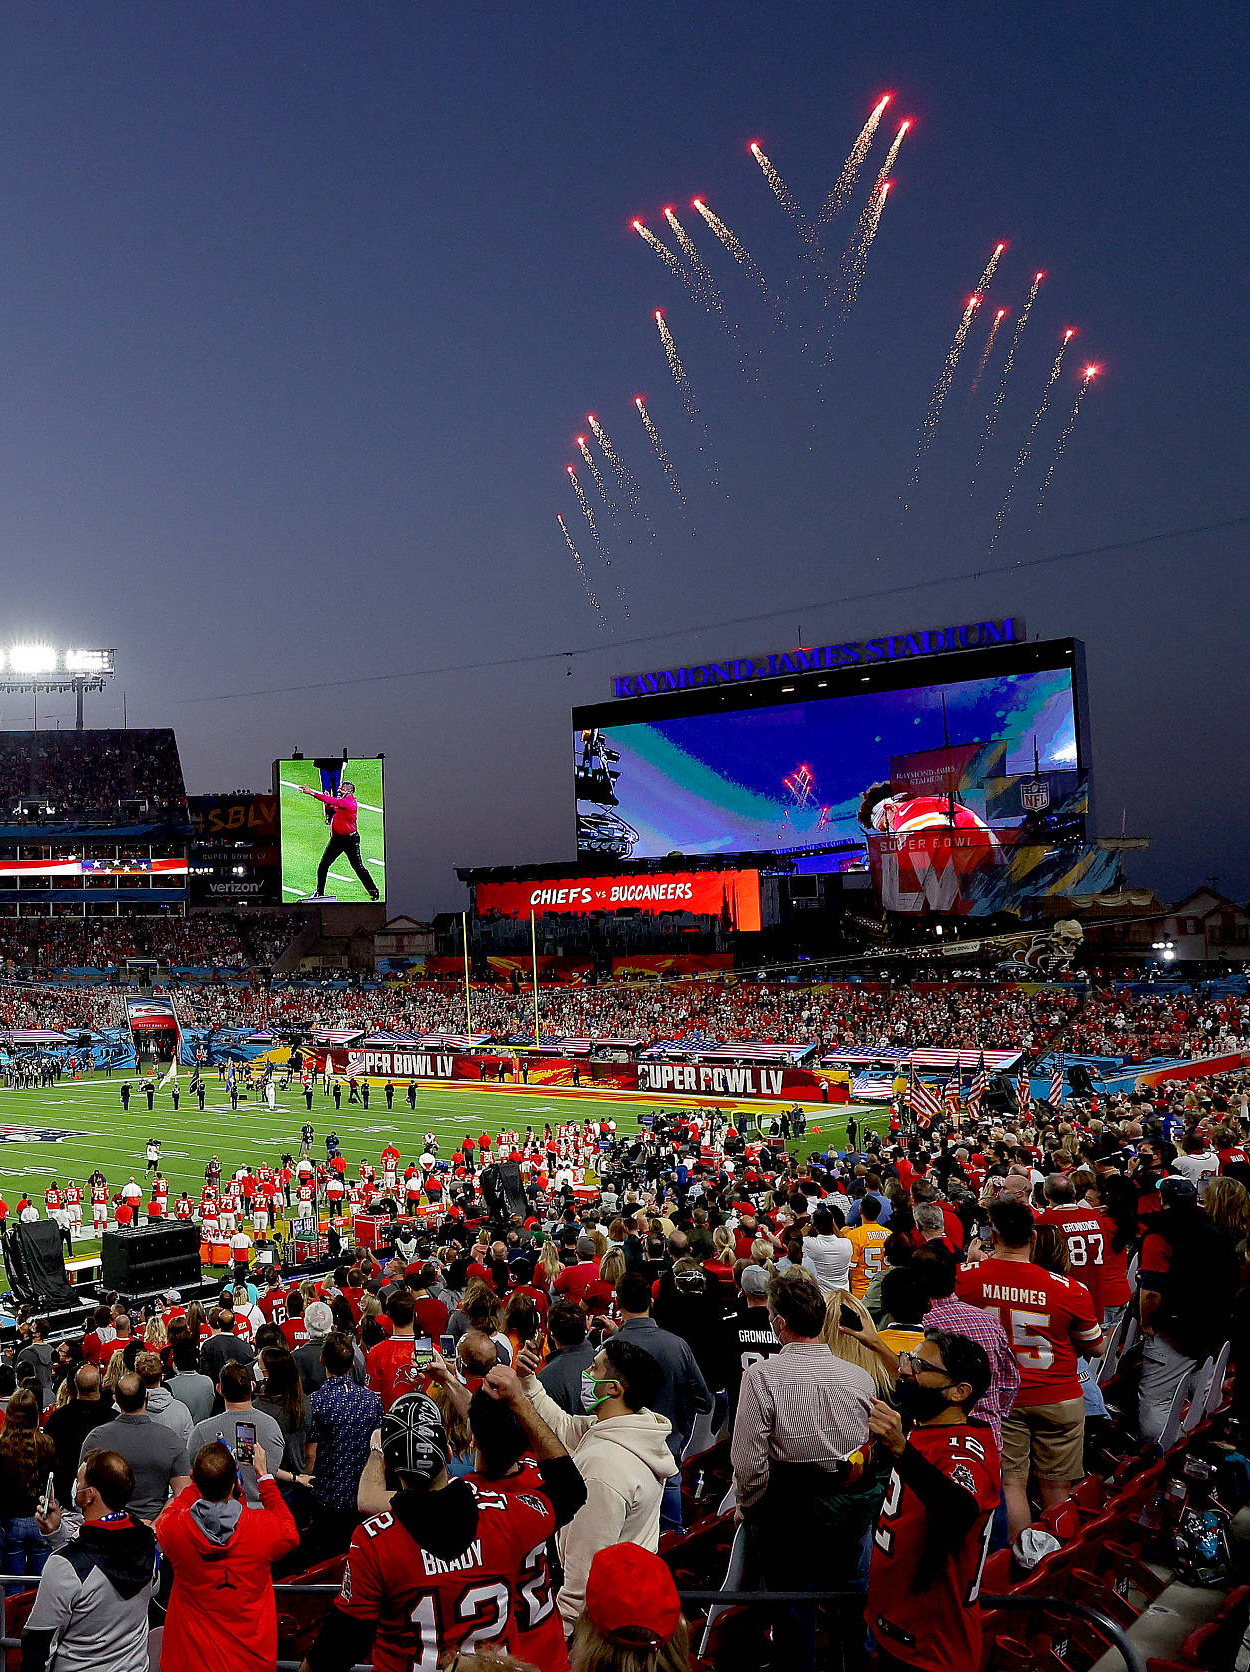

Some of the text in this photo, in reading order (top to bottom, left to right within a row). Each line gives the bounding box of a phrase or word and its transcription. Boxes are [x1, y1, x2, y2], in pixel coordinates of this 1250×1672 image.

[613, 618, 1015, 698] RAYMOND JAMES STADIUM
[896, 770, 934, 780] RAYMOND
[909, 775, 943, 785] STADIUM
[880, 838, 927, 852] SUPER
[209, 880, 261, 894] verizon
[530, 887, 593, 906] CHIEFS
[609, 883, 693, 902] BUCCANEERS
[348, 1052, 454, 1077] SPER BOWL LV
[760, 1070, 784, 1095] LV
[387, 1161, 397, 1170] 87
[47, 1192, 58, 1204] 62
[67, 1190, 78, 1201] 67
[93, 1190, 106, 1200] 75
[300, 1188, 311, 1199] 82
[350, 1191, 359, 1201] 31
[177, 1203, 190, 1214] 74
[220, 1199, 232, 1210] 73
[254, 1196, 266, 1208] 77
[203, 1204, 215, 1215] 79
[1067, 1233, 1105, 1267] 87
[863, 1246, 891, 1279] 5
[982, 1284, 1047, 1306] MAHOMES
[272, 1306, 287, 1325] 12
[986, 1306, 1055, 1370] 5
[420, 1539, 483, 1576] BRADY
[410, 1582, 509, 1672] 12
